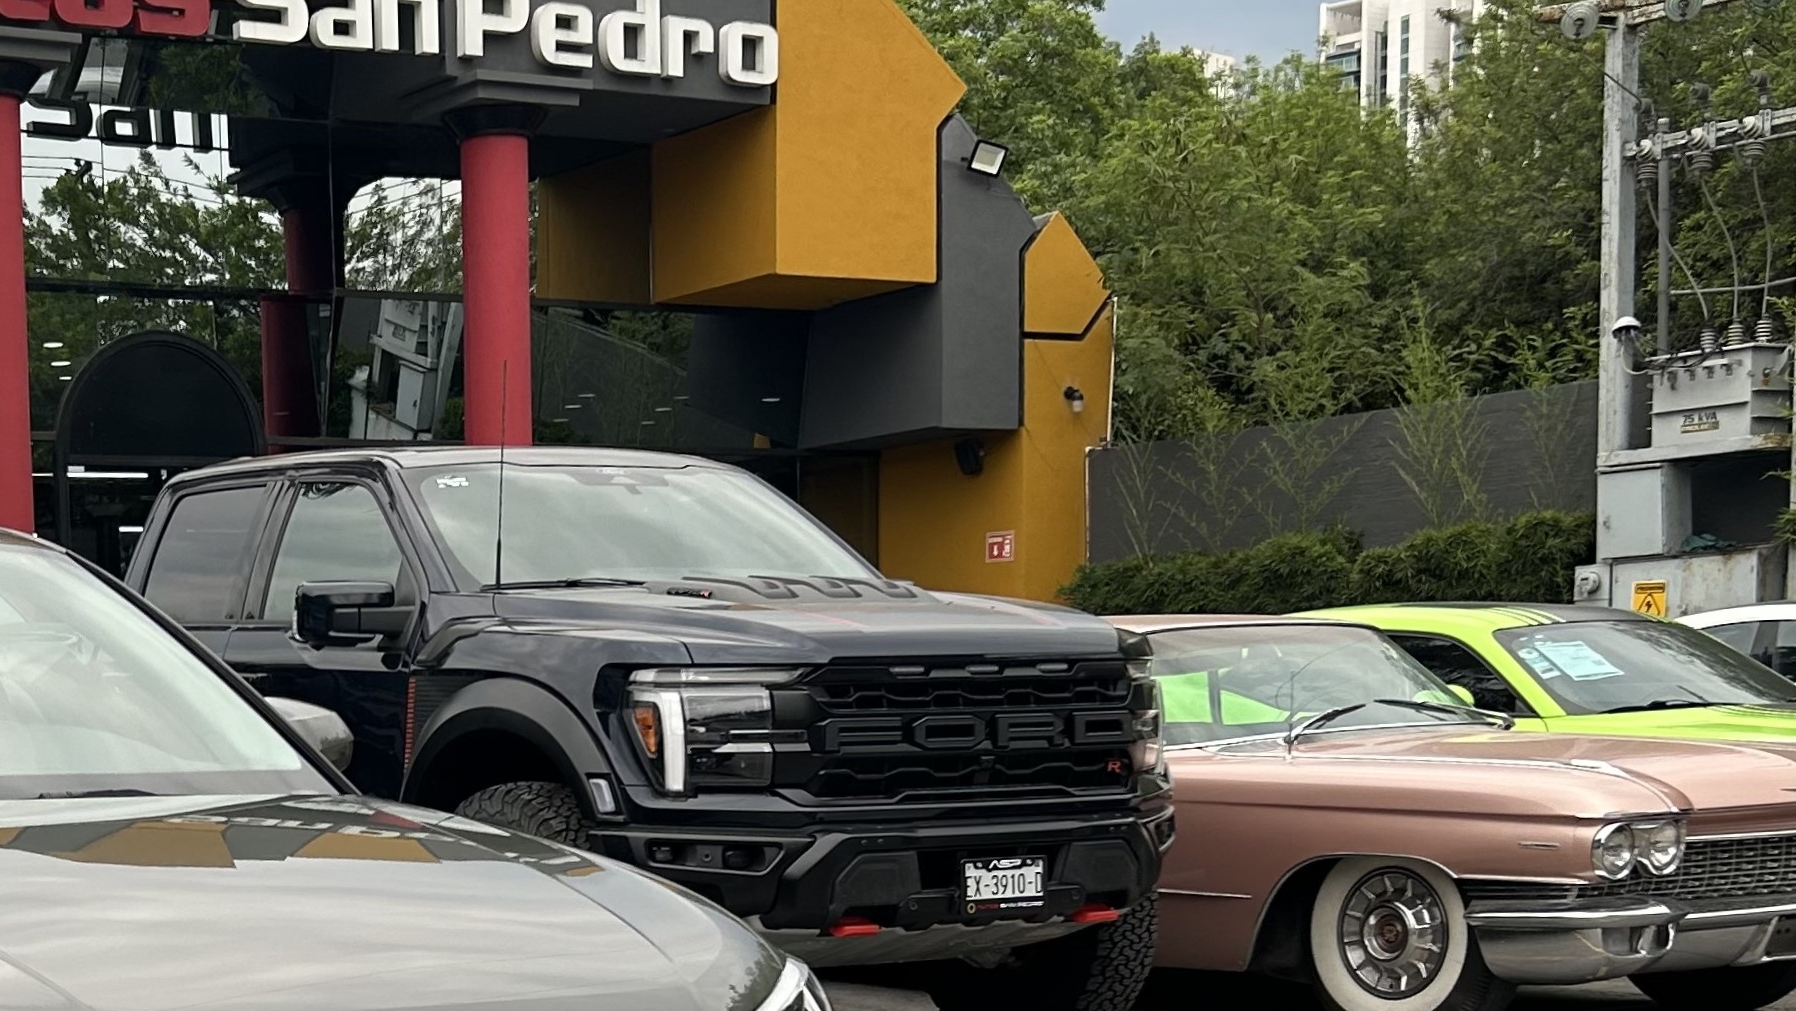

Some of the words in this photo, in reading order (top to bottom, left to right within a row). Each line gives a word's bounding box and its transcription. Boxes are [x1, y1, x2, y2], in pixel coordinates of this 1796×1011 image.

[231, 0, 439, 56] San
[457, 0, 780, 87] Pedro
[816, 709, 1134, 753] FORD
